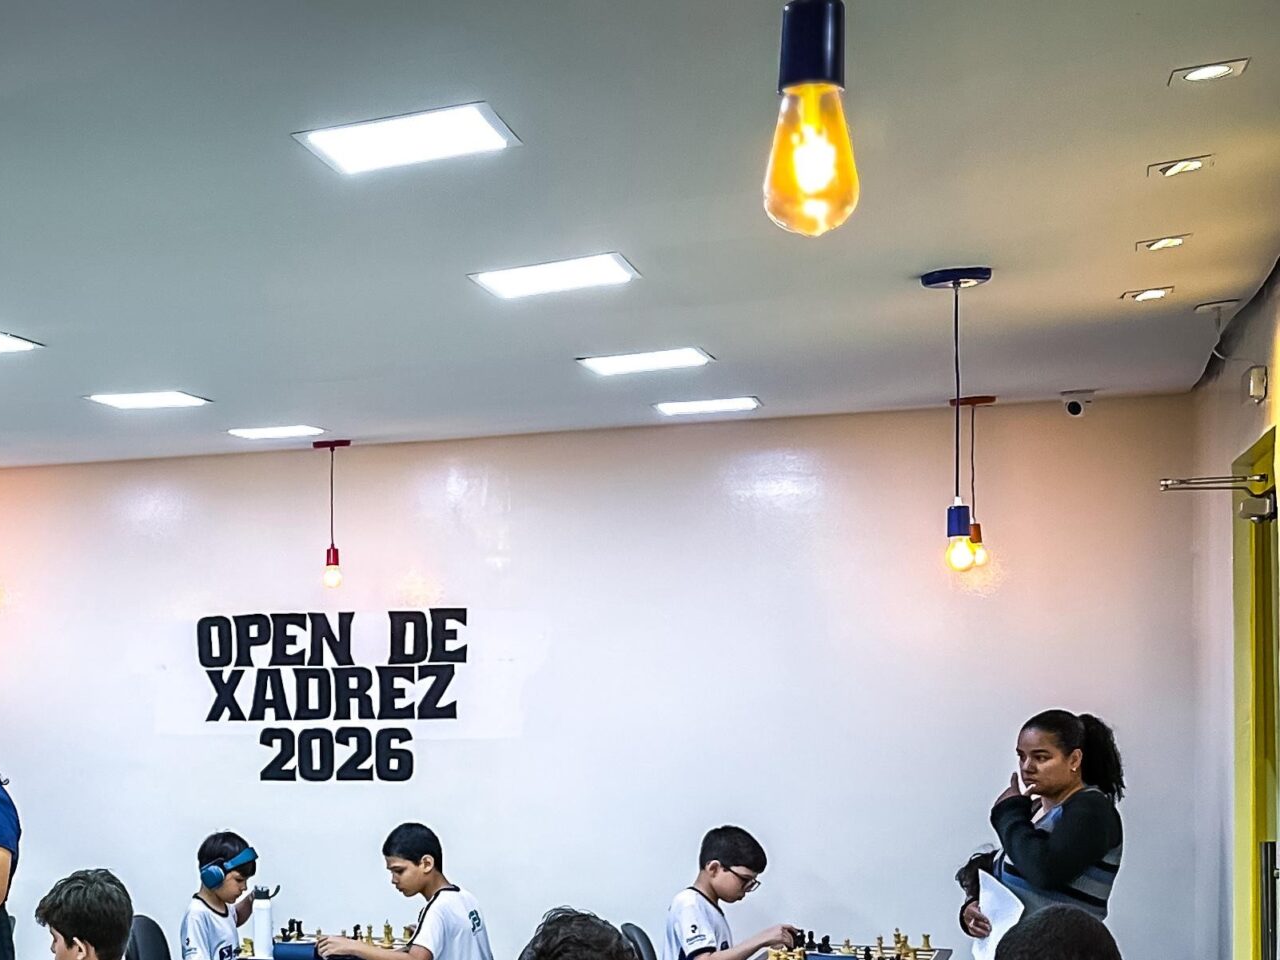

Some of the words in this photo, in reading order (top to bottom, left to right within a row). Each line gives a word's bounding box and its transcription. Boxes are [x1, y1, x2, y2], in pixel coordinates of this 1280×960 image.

[197, 612, 355, 667] OPEN
[388, 608, 467, 665] DE
[205, 664, 457, 721] XADREZ
[260, 727, 414, 781] 2026
